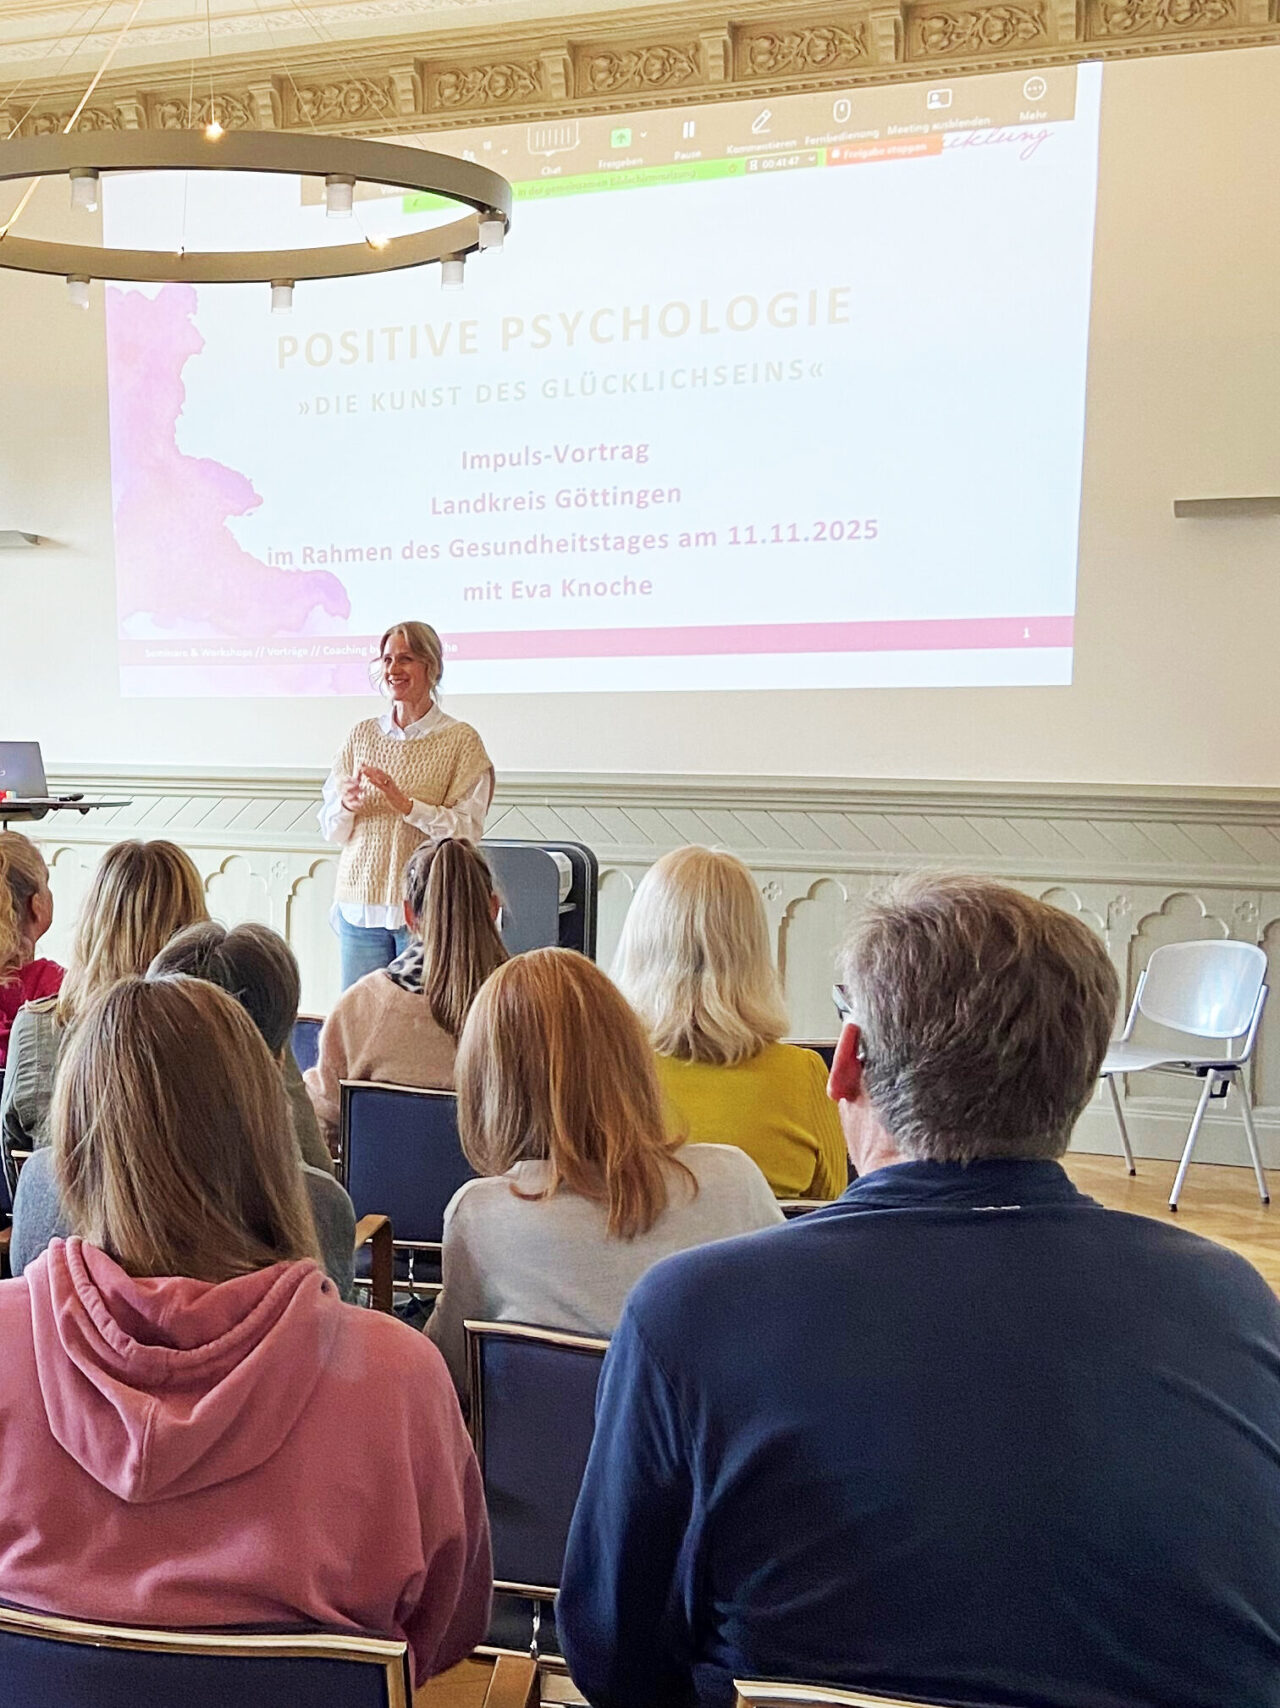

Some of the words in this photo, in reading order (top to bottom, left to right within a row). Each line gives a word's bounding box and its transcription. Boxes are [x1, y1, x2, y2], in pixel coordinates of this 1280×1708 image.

[1019, 110, 1049, 121] Mehr
[887, 123, 930, 135] Meeting
[931, 116, 992, 131] ausblenden
[805, 129, 880, 145] Fernbedienung
[726, 139, 798, 154] Kommentieren
[674, 151, 702, 161] Pause
[541, 166, 563, 176] Chat
[277, 319, 479, 370] POSITIVE
[501, 286, 852, 352] PSYCHOLOGIE
[298, 394, 359, 416] »DIE
[371, 386, 462, 413] KUNST
[476, 380, 527, 404] DES
[541, 359, 824, 400] GLÜCKLICHSEINS«
[462, 443, 650, 473] Impuls-Vortrag
[431, 490, 547, 516] Landkreis
[555, 485, 681, 510] Göttingen
[267, 547, 294, 566] im
[302, 543, 393, 565] Rahmen
[401, 539, 441, 560] des
[448, 531, 670, 559] Gesundheitstages
[678, 531, 717, 548] am
[728, 519, 879, 546] 11.11.2025
[463, 580, 503, 602] mit
[511, 580, 553, 600] Eva
[561, 575, 654, 598] Knoche
[1023, 627, 1031, 639] 1
[323, 644, 367, 656] Coaching
